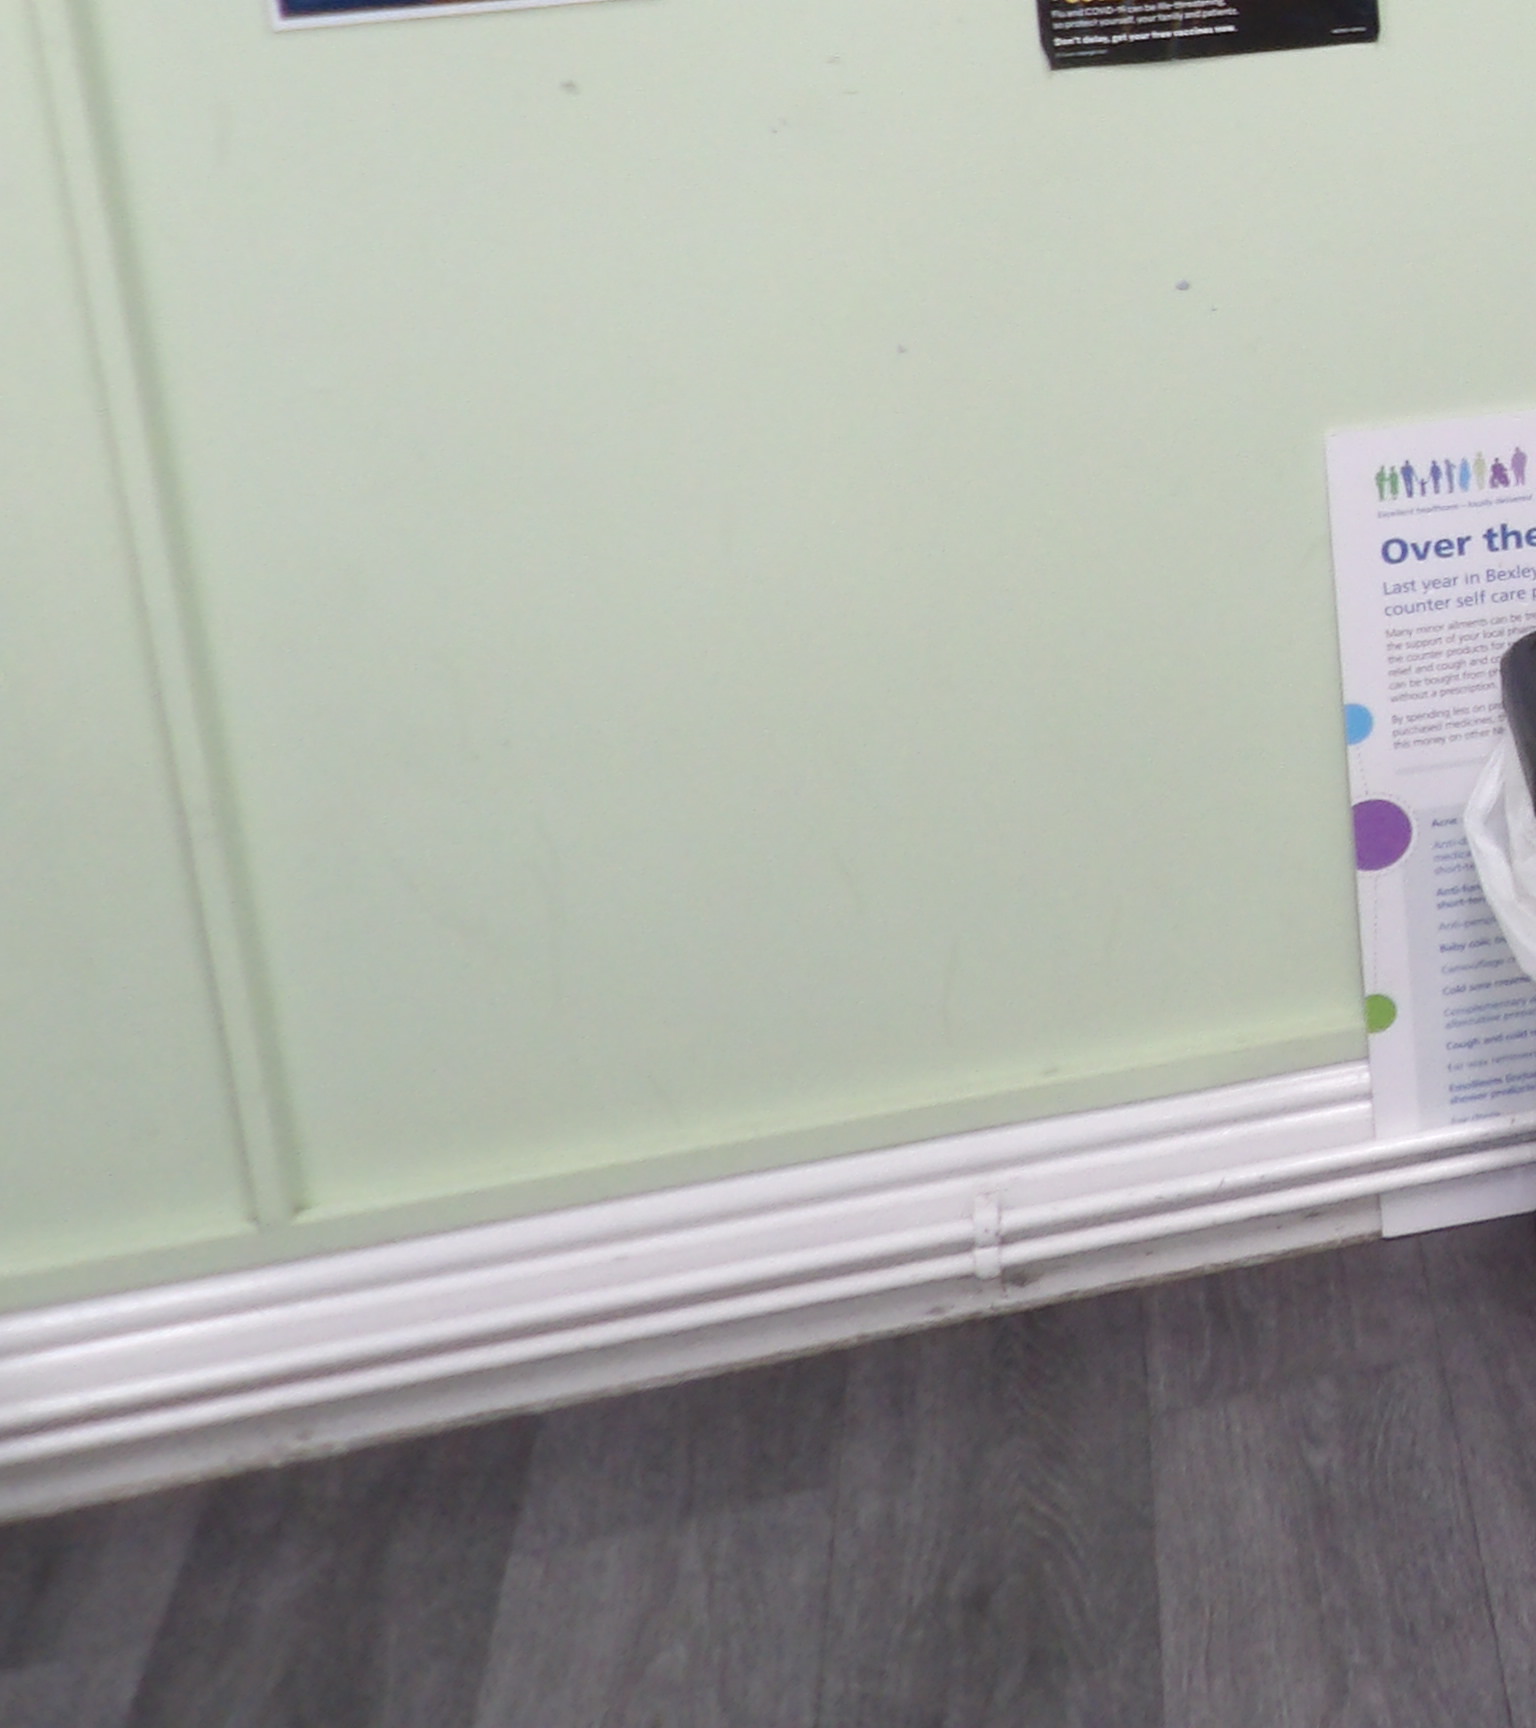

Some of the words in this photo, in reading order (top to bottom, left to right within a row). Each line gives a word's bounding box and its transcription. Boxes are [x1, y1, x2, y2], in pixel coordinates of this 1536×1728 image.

[1381, 533, 1472, 566] Over
[1383, 577, 1418, 596] Last
[1421, 574, 1458, 595] year
[1464, 569, 1481, 587] in
